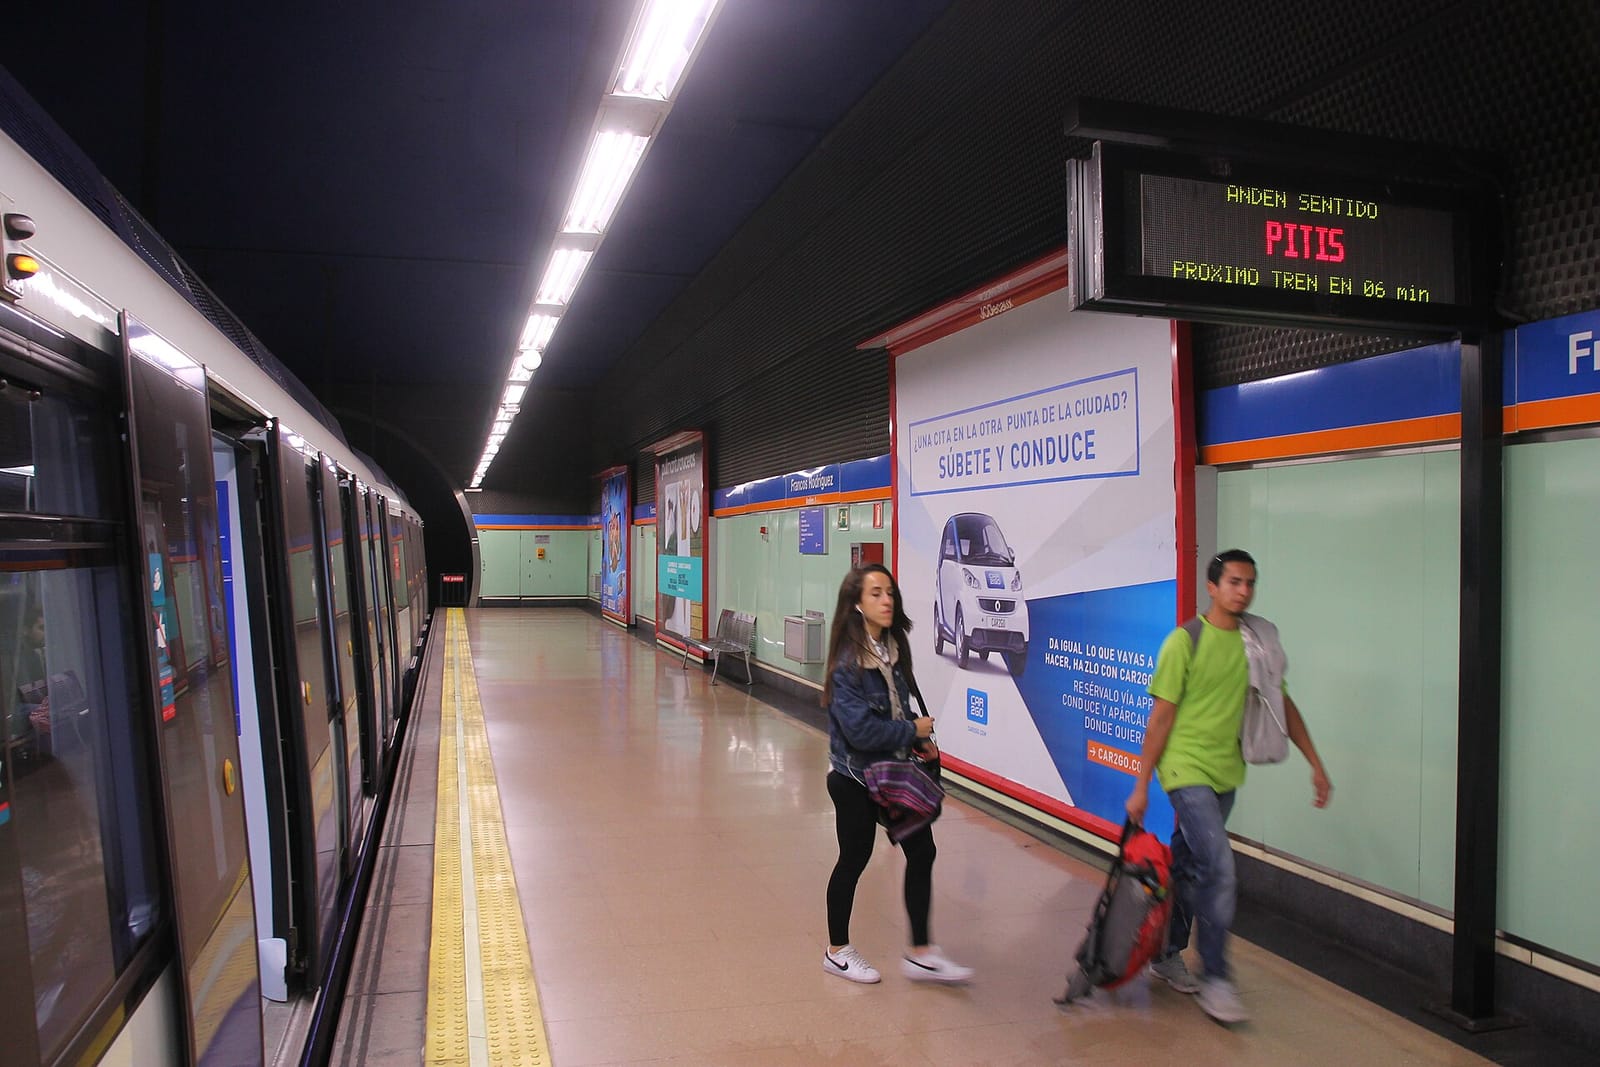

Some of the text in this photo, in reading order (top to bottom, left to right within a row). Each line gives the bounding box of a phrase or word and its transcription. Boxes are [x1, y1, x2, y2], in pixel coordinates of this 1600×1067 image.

[1227, 184, 1378, 219] ANDEN SENTIDO
[1266, 220, 1345, 262] PITIS
[1172, 261, 1430, 302] PROXIMO TREN EN 06 min
[913, 390, 1129, 453] ¿UNA CITA EN LA OTRA PUNTA DE LA CIUDAD?
[939, 429, 1096, 479] SÚBETE Y CONDUCE
[790, 479, 808, 492] Francos
[1045, 653, 1072, 671] HACER,
[1073, 658, 1100, 675] HAZLO
[1101, 664, 1118, 679] CON
[1049, 637, 1154, 669] DA IGUAL LO QUE VAYAS A
[1062, 693, 1100, 715] CONDUCE
[1102, 703, 1107, 716] Y
[1073, 679, 1119, 703] RESÉRVALO
[1121, 689, 1135, 706] VÍA
[1084, 716, 1113, 736] DONDE
[1097, 748, 1142, 774] CAR2GO.CO
